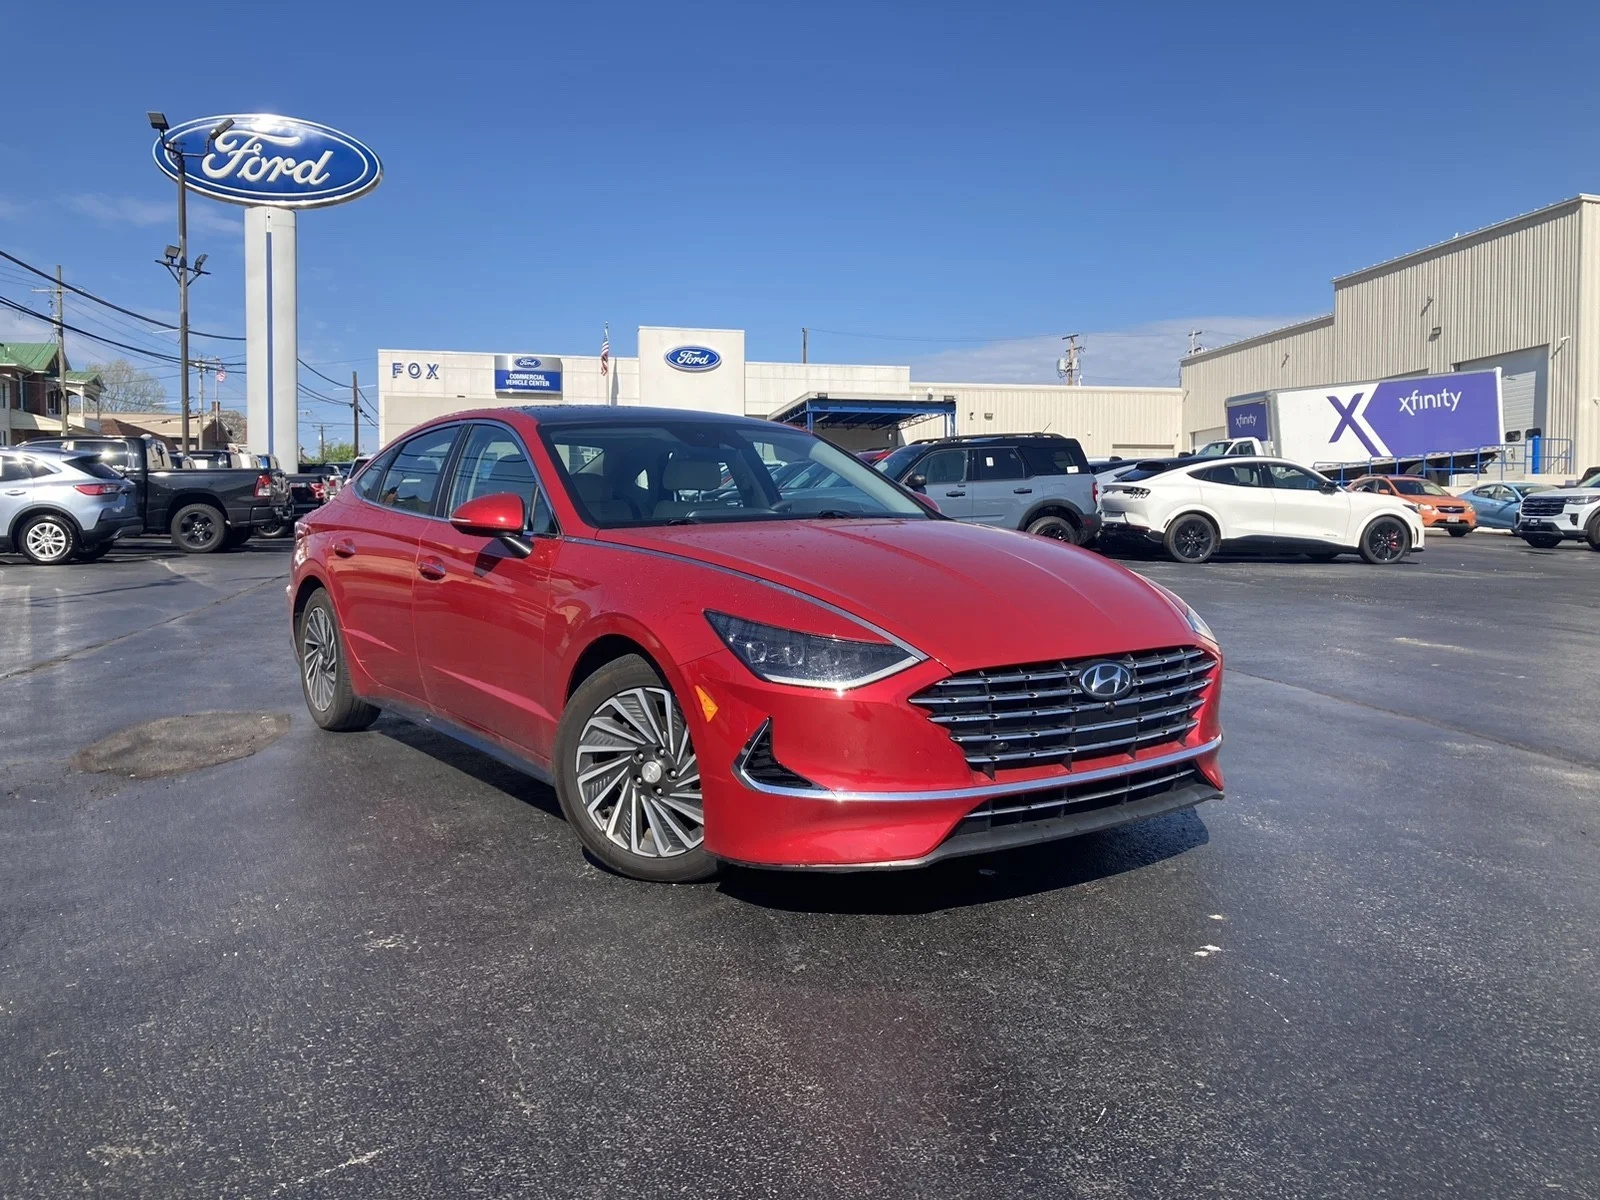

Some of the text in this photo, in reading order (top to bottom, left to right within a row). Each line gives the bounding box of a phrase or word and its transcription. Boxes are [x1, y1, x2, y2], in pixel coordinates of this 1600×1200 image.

[201, 129, 334, 185] Ford
[676, 350, 710, 365] Ford
[392, 362, 439, 378] FOX
[509, 373, 546, 381] COMMERCIAL
[1398, 387, 1463, 416] xfinity
[1235, 413, 1257, 428] xfinity
